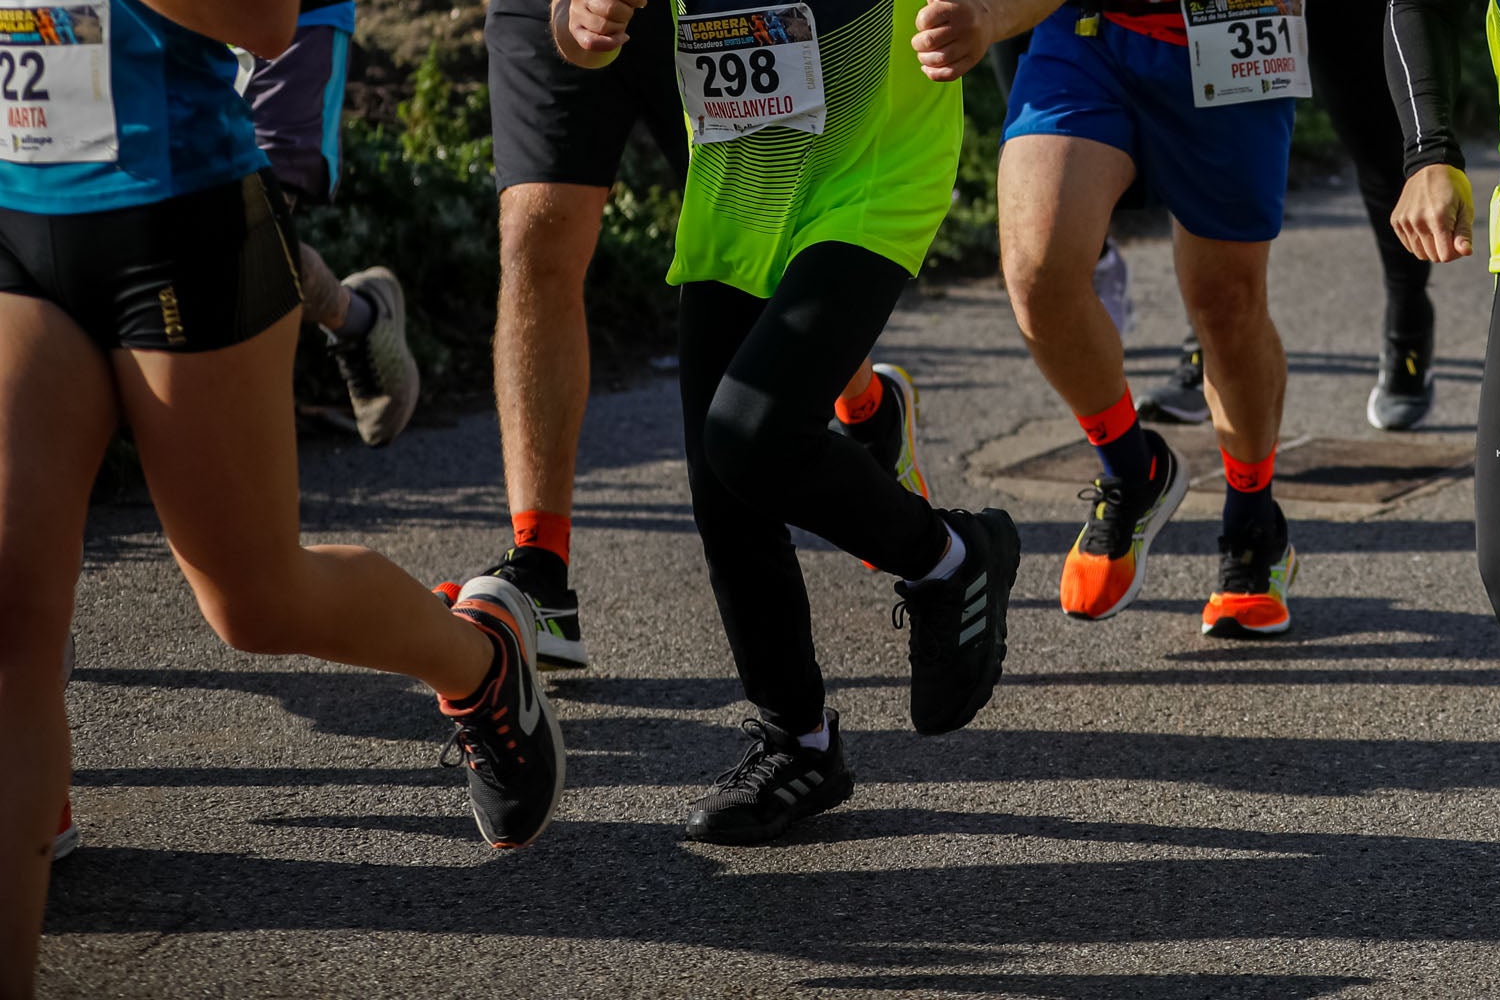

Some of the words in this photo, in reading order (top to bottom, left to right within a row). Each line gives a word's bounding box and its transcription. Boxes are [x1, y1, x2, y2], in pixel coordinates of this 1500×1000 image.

[691, 17, 749, 32] CARRERA
[693, 28, 749, 40] POPULAR
[1228, 18, 1291, 59] 351
[693, 41, 723, 49] Secaderos
[696, 49, 779, 98] 298
[1231, 60, 1260, 78] PEPE
[704, 96, 793, 119] MANUELANYELO
